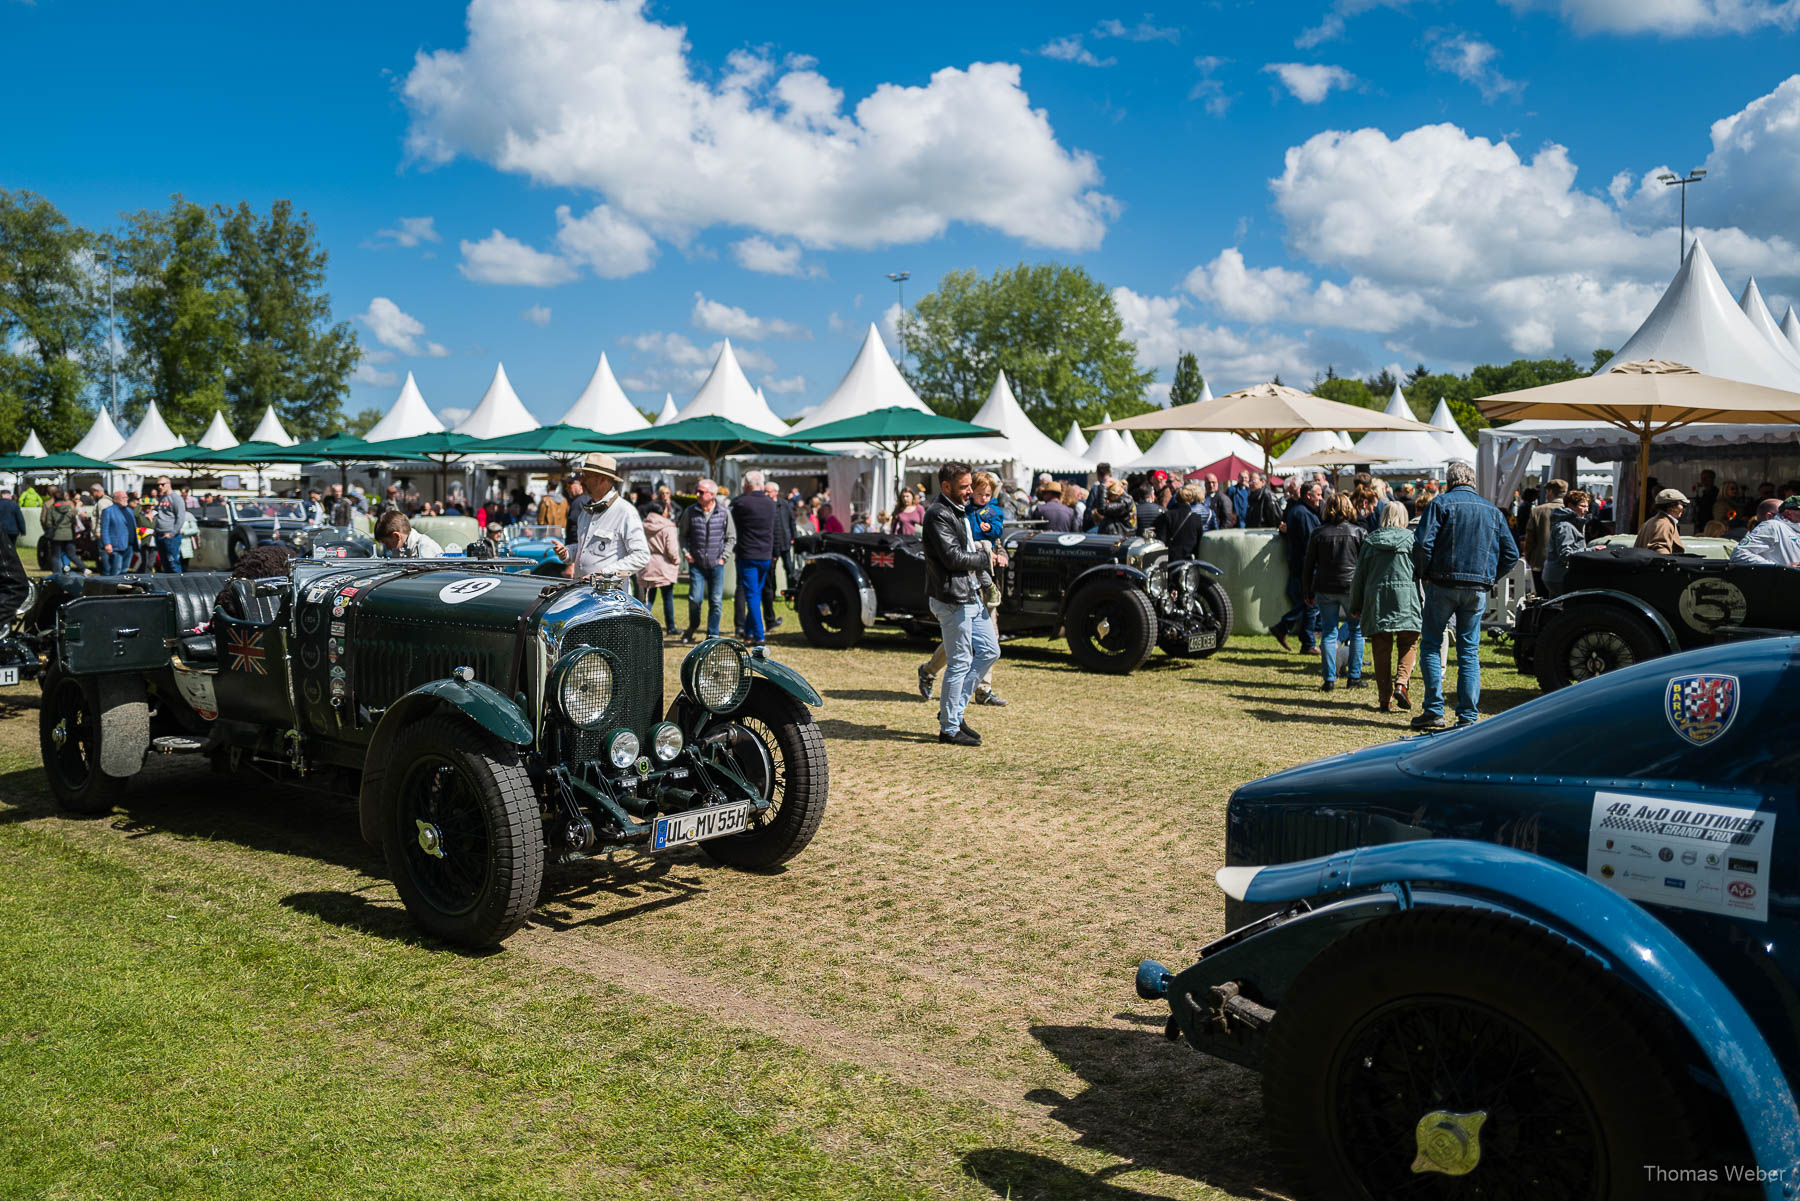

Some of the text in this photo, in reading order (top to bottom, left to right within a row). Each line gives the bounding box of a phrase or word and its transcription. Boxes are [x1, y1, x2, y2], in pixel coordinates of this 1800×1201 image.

[449, 581, 492, 594] 49
[1692, 583, 1731, 625] 5
[1672, 684, 1682, 720] BARC
[667, 807, 746, 842] UL MV 55H
[1606, 802, 1764, 833] 46. AvD OLDTIMER
[1662, 823, 1735, 843] GRAND PRIX
